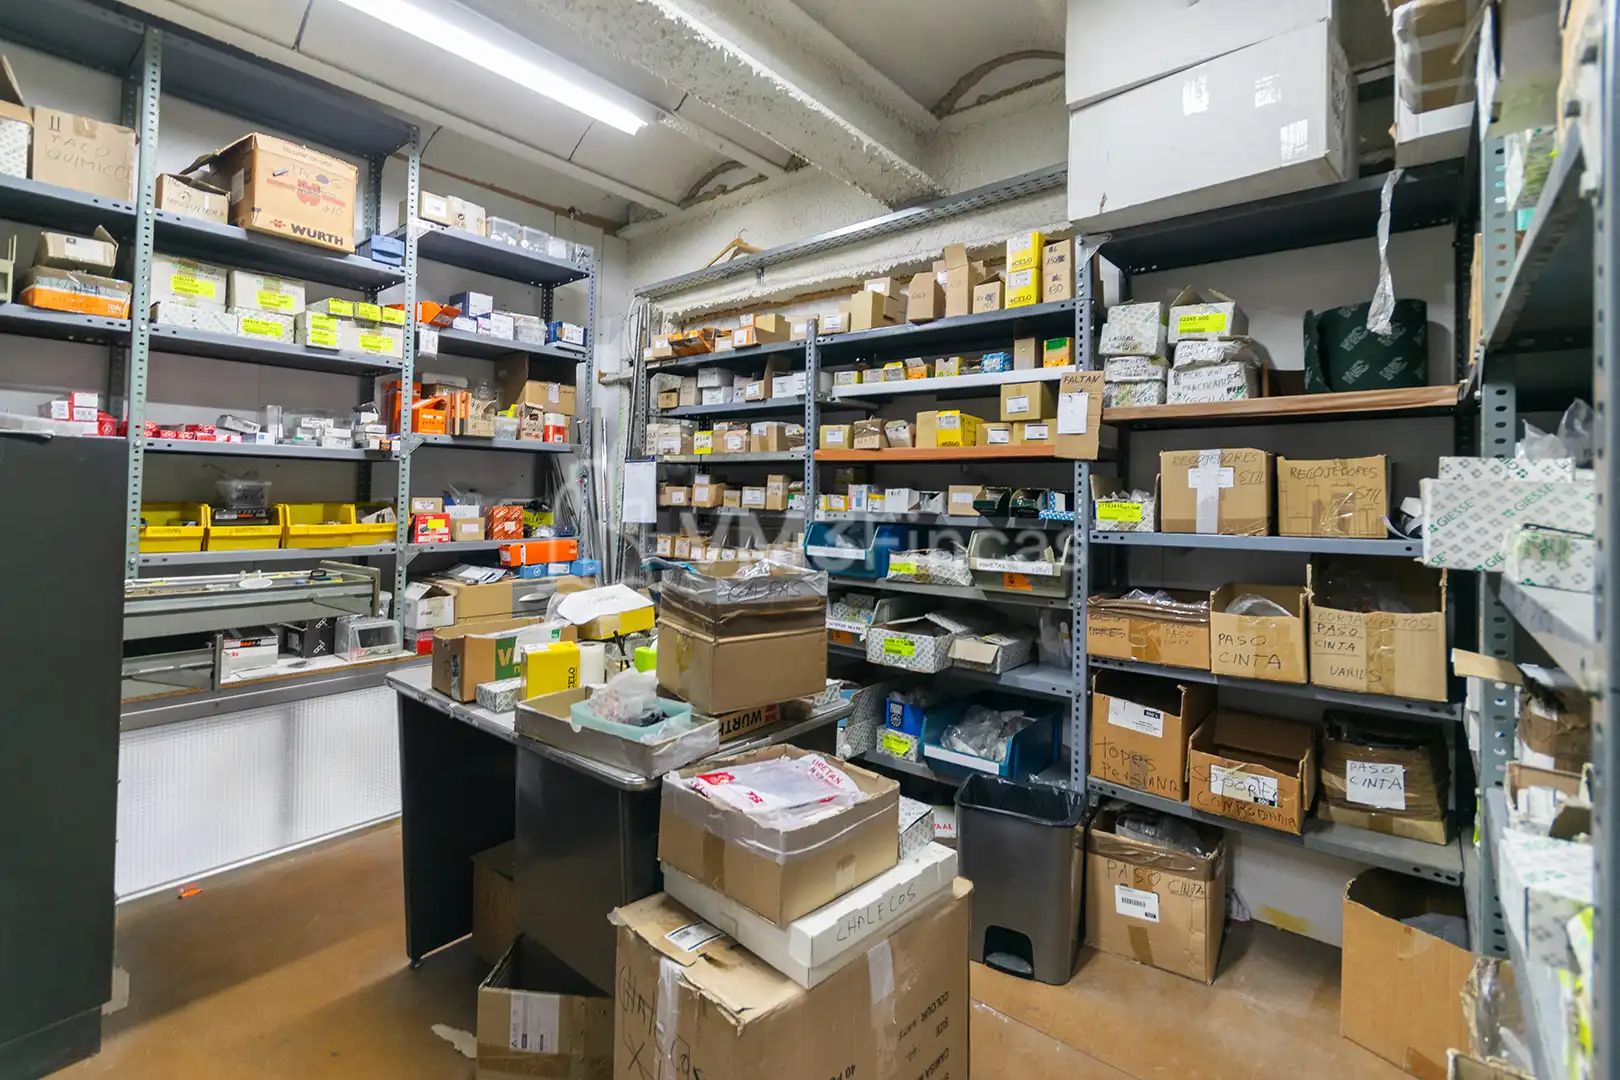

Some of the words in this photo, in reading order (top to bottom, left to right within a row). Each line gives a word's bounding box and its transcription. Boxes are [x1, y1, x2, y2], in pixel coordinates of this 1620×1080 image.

[52, 134, 111, 157] TACO
[47, 147, 130, 181] QUIMICO
[1063, 375, 1100, 384] FALTAN
[1514, 483, 1556, 512] GIESSE
[1437, 498, 1475, 527] GIESSE
[1316, 623, 1358, 637] PASO
[1218, 633, 1267, 646] PASO
[1314, 641, 1356, 652] CINTA
[1218, 652, 1282, 670] CINTA
[1330, 665, 1382, 683] VARIOS
[1350, 762, 1395, 774] PASO
[1349, 776, 1402, 790] CINTA
[1107, 859, 1161, 886] PASO
[836, 883, 916, 942] CHALECOS
[845, 1064, 856, 1079] 40
